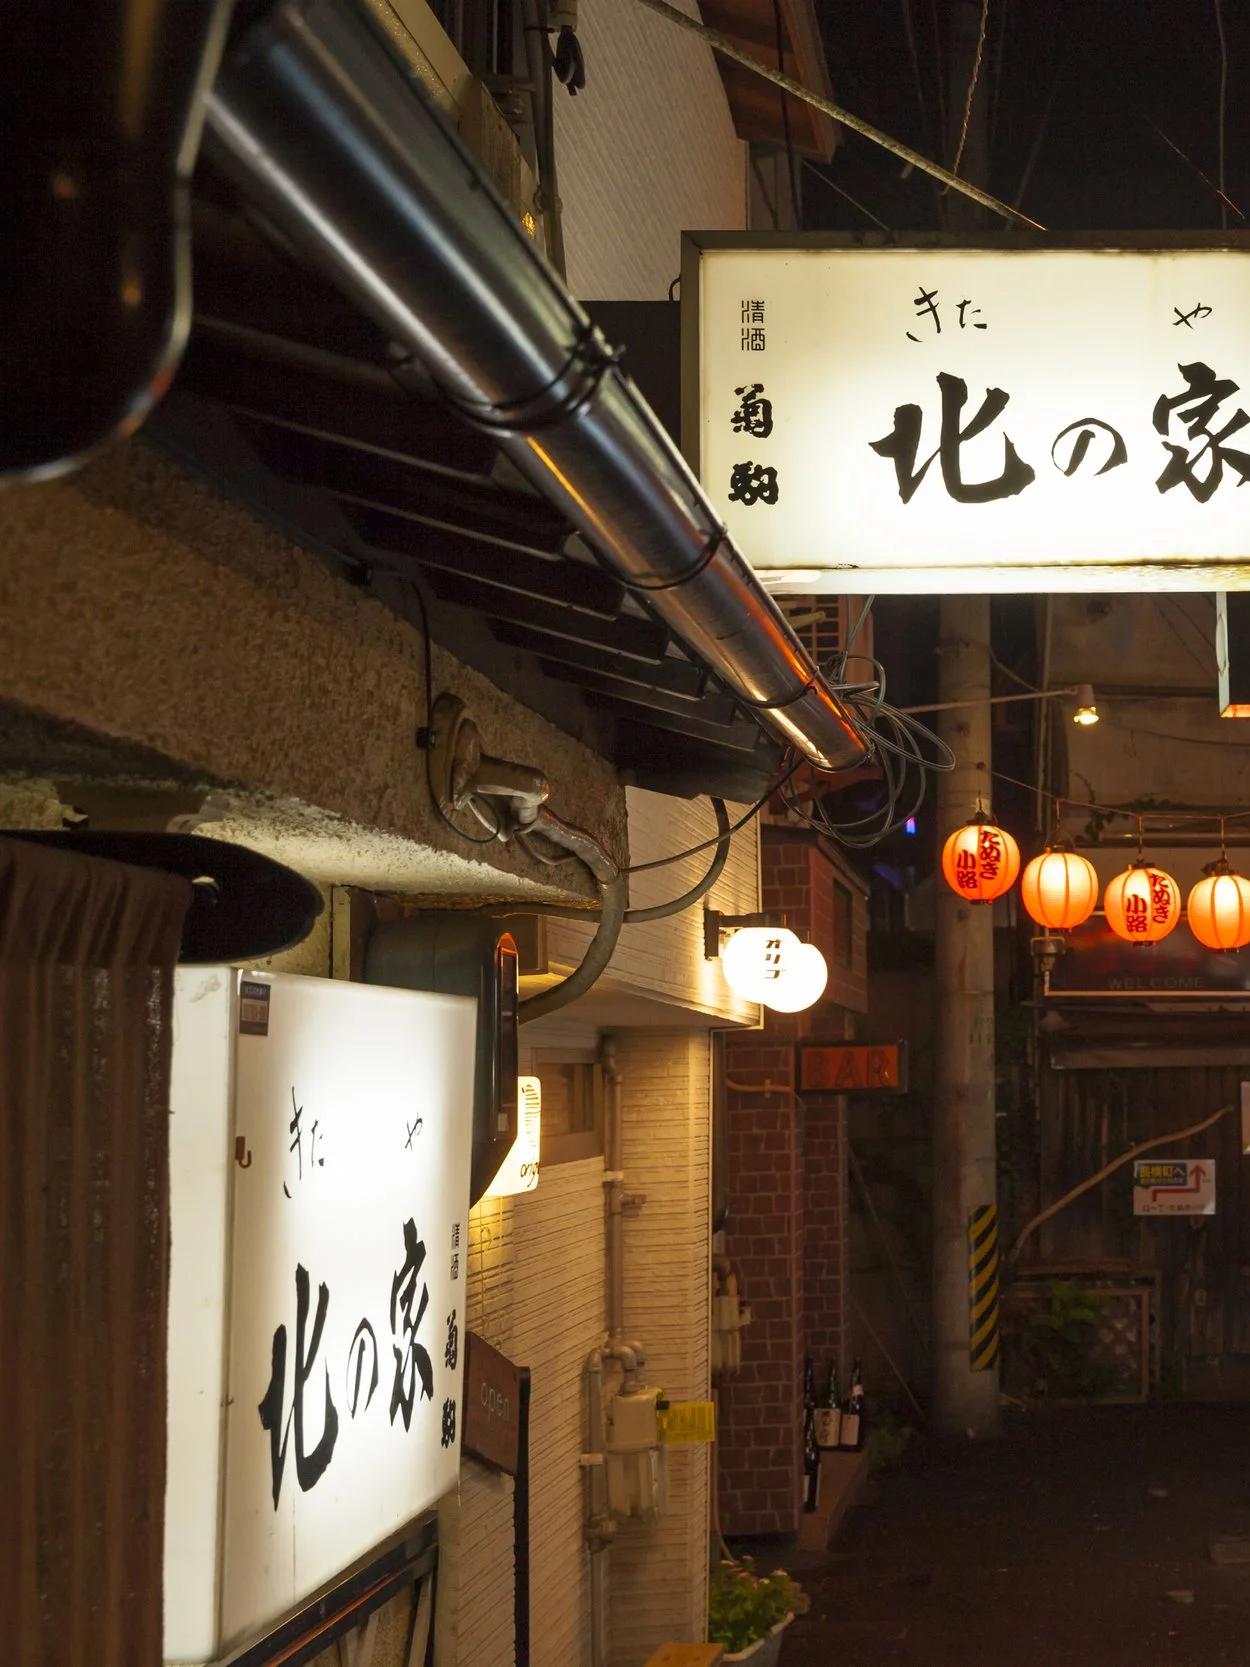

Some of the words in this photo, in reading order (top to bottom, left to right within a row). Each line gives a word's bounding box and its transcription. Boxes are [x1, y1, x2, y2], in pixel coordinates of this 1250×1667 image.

[740, 299, 766, 353] 清酒
[906, 286, 988, 343] きた
[1172, 302, 1213, 331] や
[728, 384, 779, 506] 菊駒
[957, 849, 978, 889] 小路
[980, 830, 1001, 880] たぬき
[1126, 894, 1148, 933] 小路
[1149, 873, 1171, 924] たぬき
[1108, 976, 1205, 991] WELCOME
[806, 1049, 893, 1089] BAR
[283, 1086, 325, 1199] きた
[406, 1111, 423, 1151] や
[258, 1217, 434, 1511] 北の家
[480, 1382, 510, 1422] open
